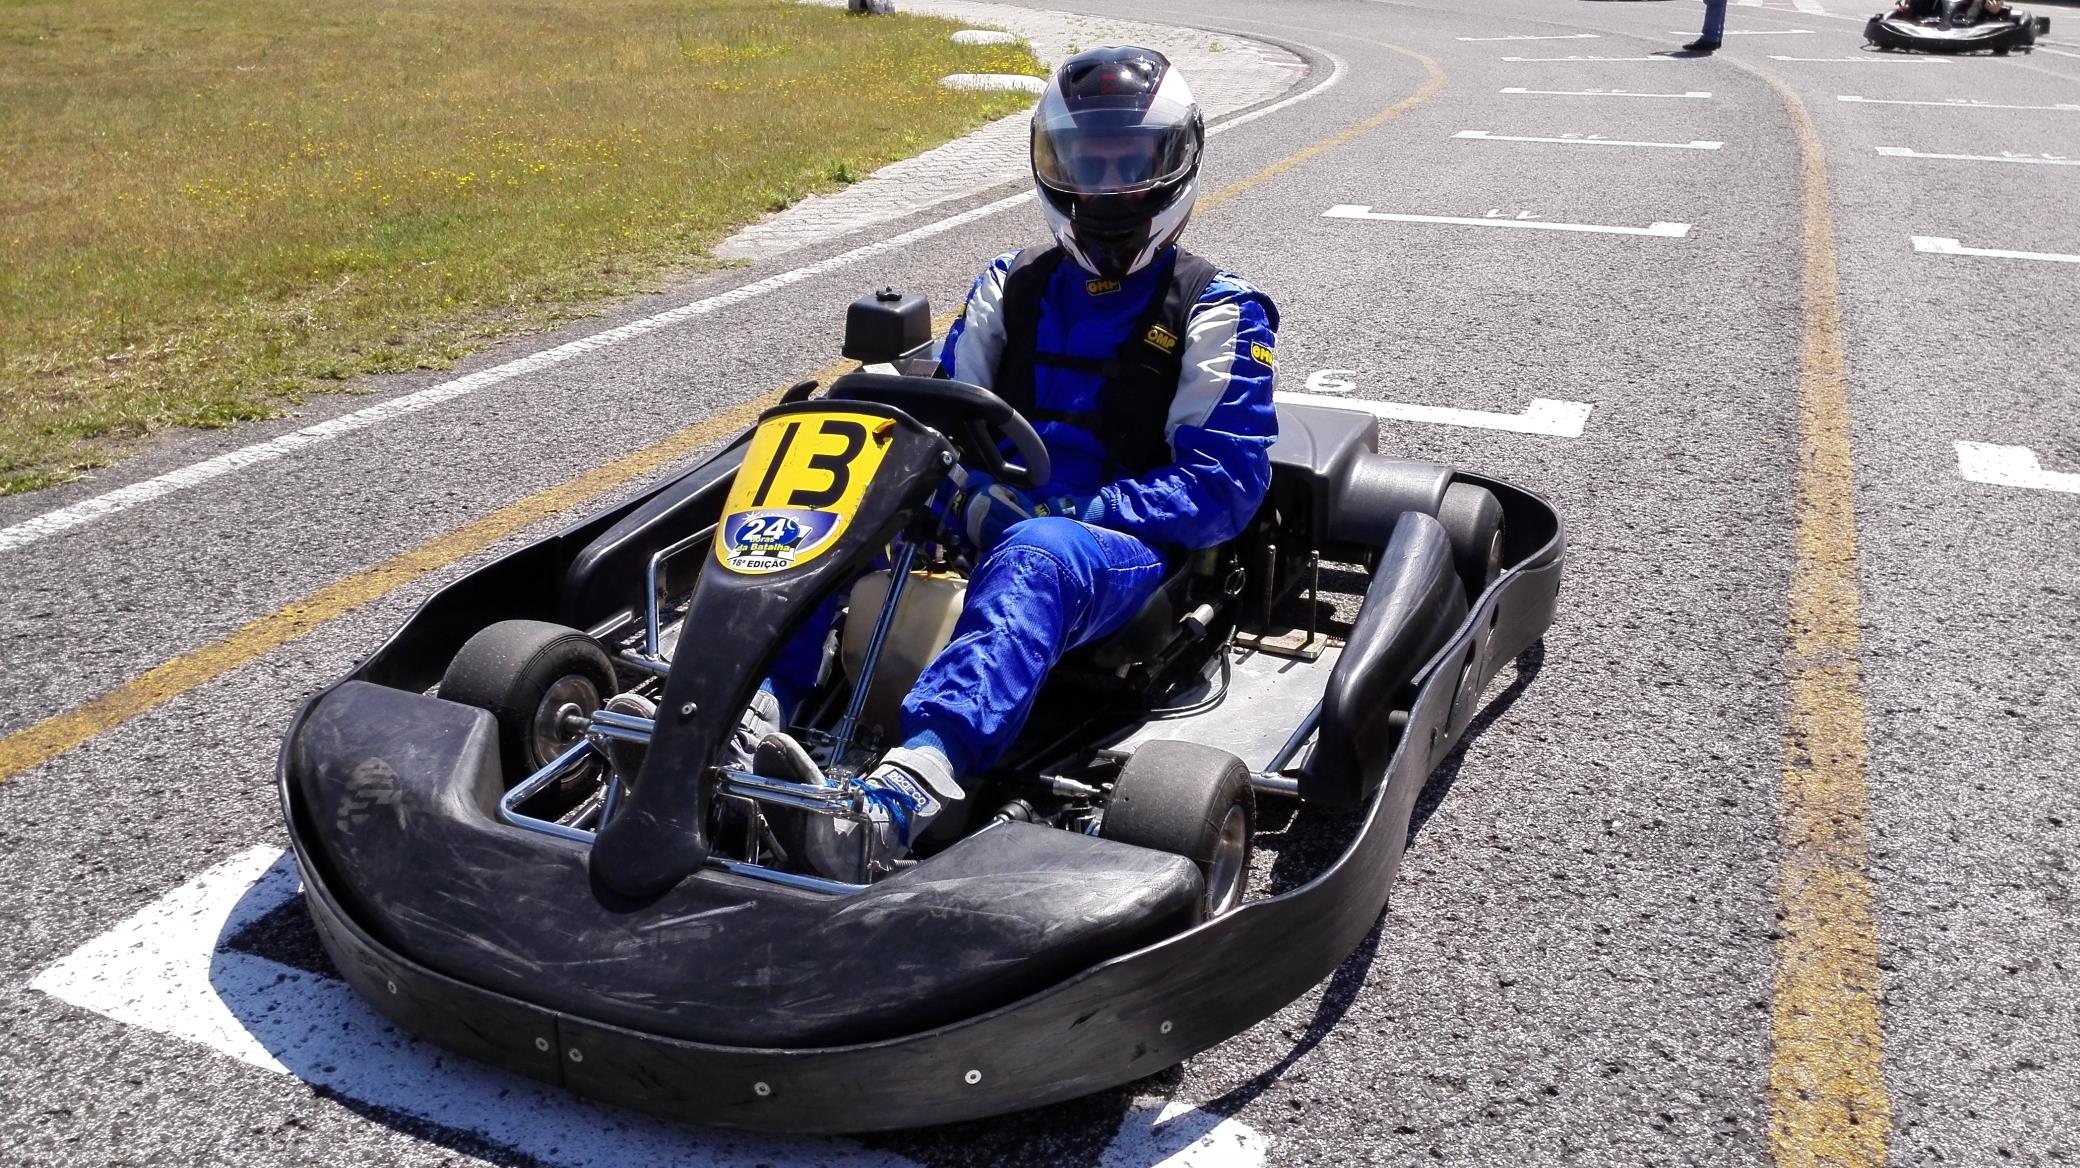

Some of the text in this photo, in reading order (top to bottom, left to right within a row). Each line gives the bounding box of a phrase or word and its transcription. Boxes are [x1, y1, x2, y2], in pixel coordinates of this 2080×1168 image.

[1147, 329, 1176, 350] OMP
[751, 419, 867, 509] 13
[742, 518, 786, 541] 24
[736, 543, 791, 553] da Batalha
[747, 559, 787, 569] EDIÇÃO
[889, 770, 926, 805] sparco
